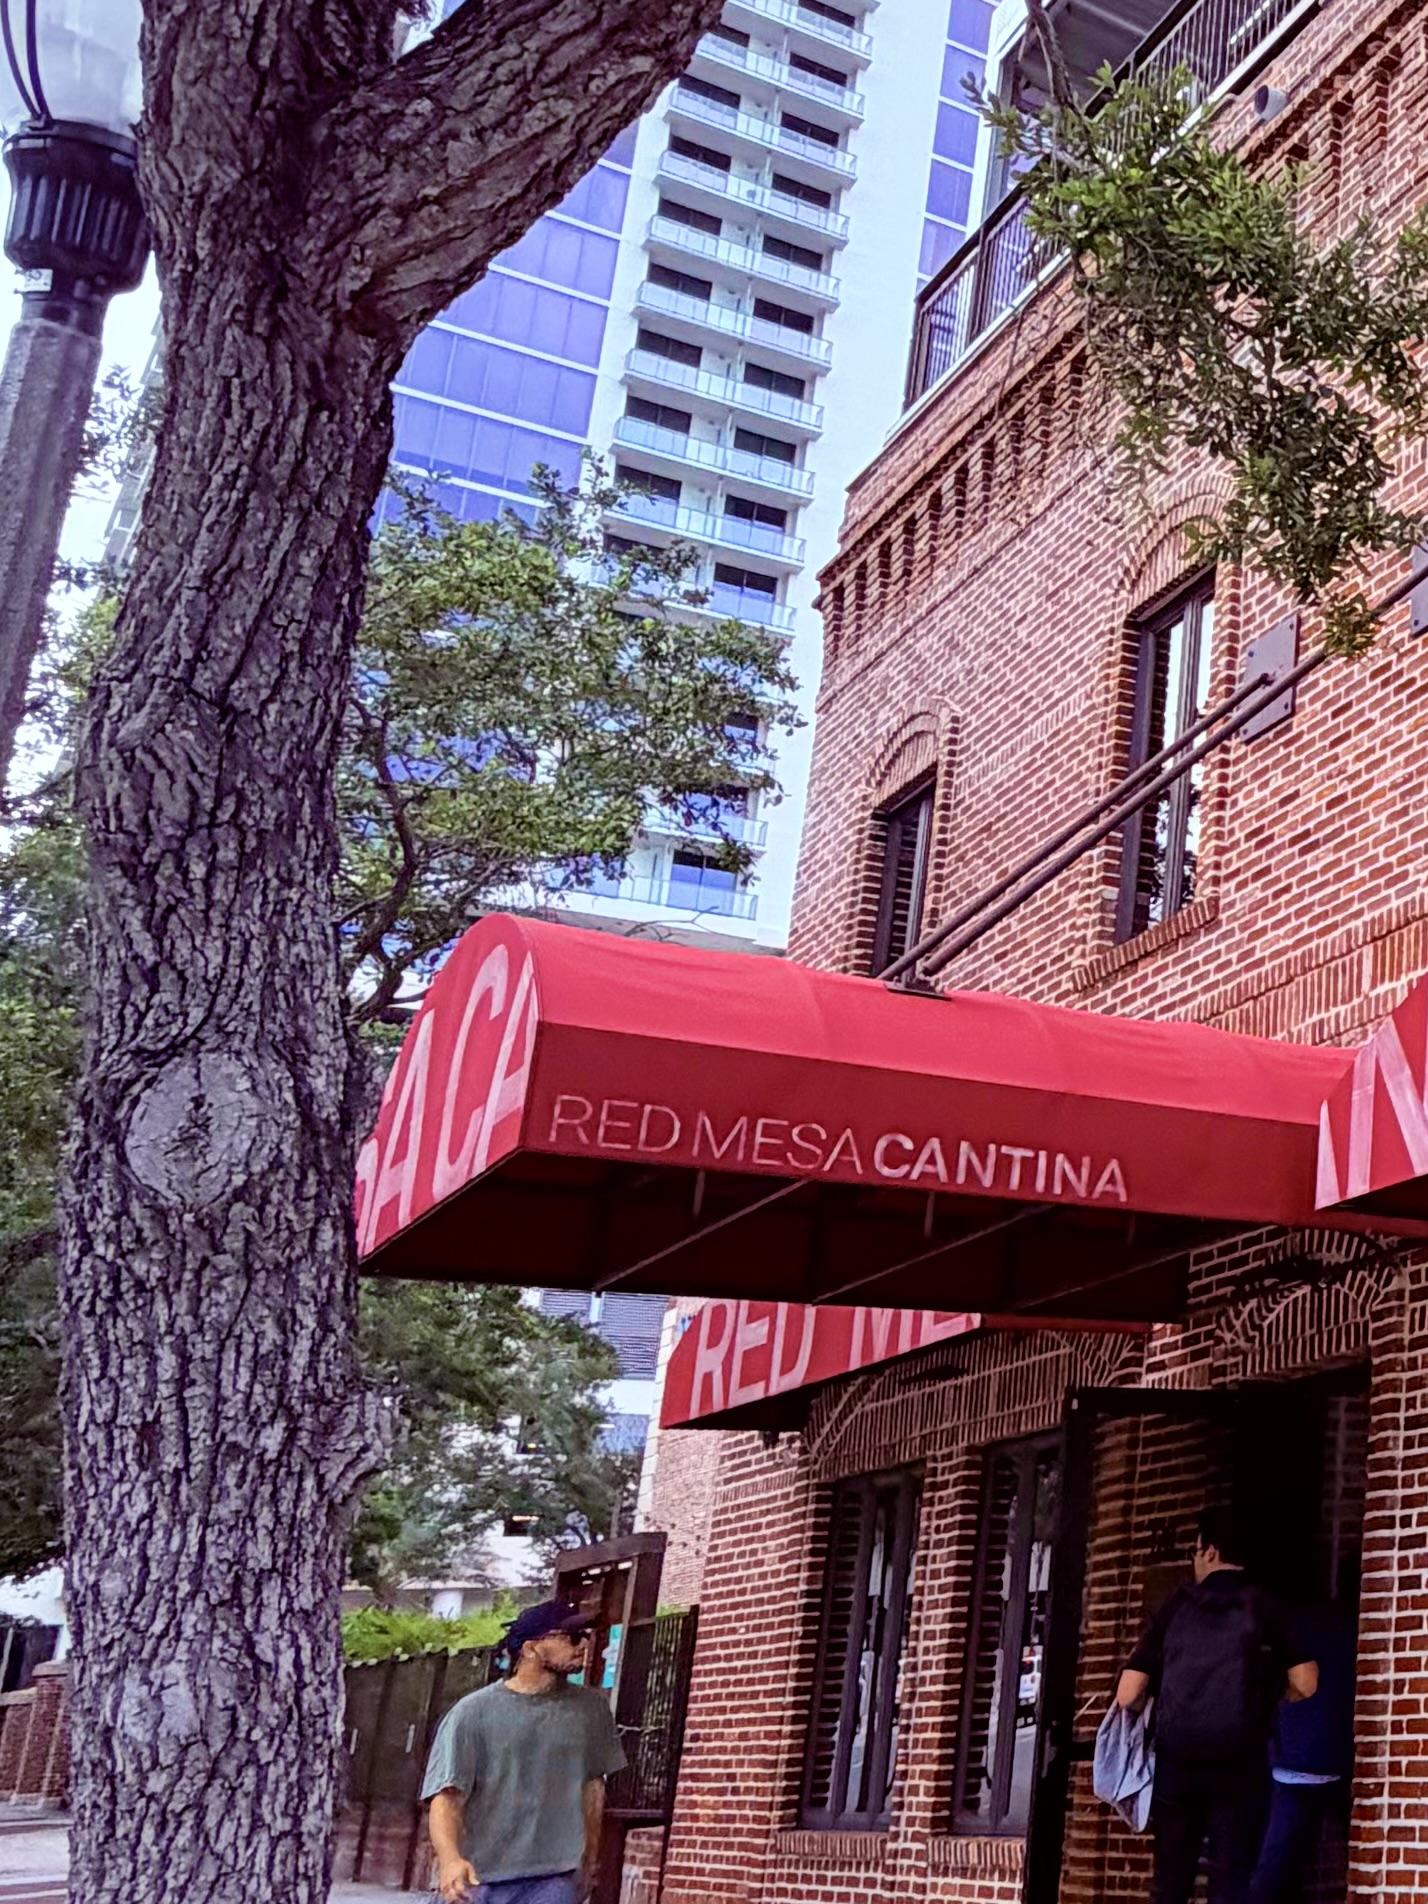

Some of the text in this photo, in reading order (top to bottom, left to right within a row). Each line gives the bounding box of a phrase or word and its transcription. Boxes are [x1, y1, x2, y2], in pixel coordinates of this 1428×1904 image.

[549, 1094, 1128, 1202] RED MESA CANTINA
[689, 1299, 817, 1420] RED
